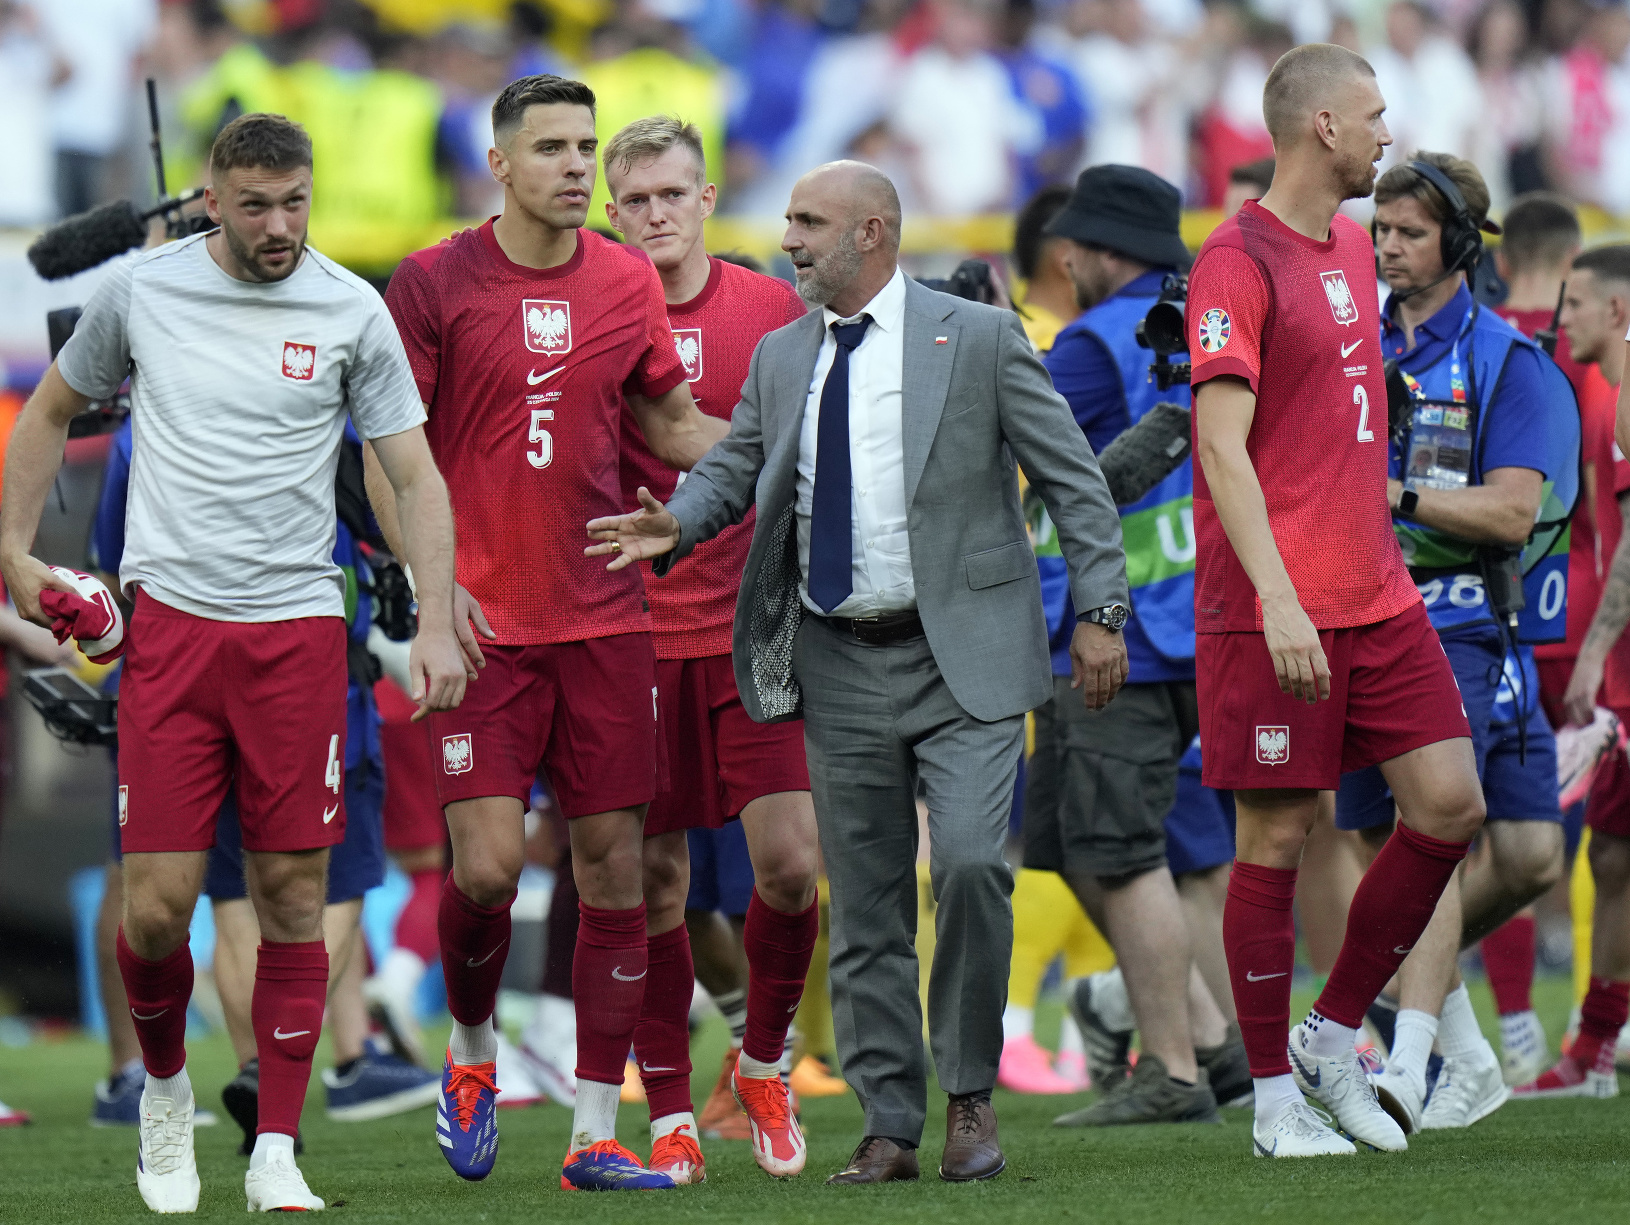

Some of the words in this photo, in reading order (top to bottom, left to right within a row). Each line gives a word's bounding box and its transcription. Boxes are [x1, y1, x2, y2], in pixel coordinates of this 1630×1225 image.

[527, 409, 555, 469] 5
[1353, 384, 1374, 443] 2
[325, 733, 340, 794] 4
